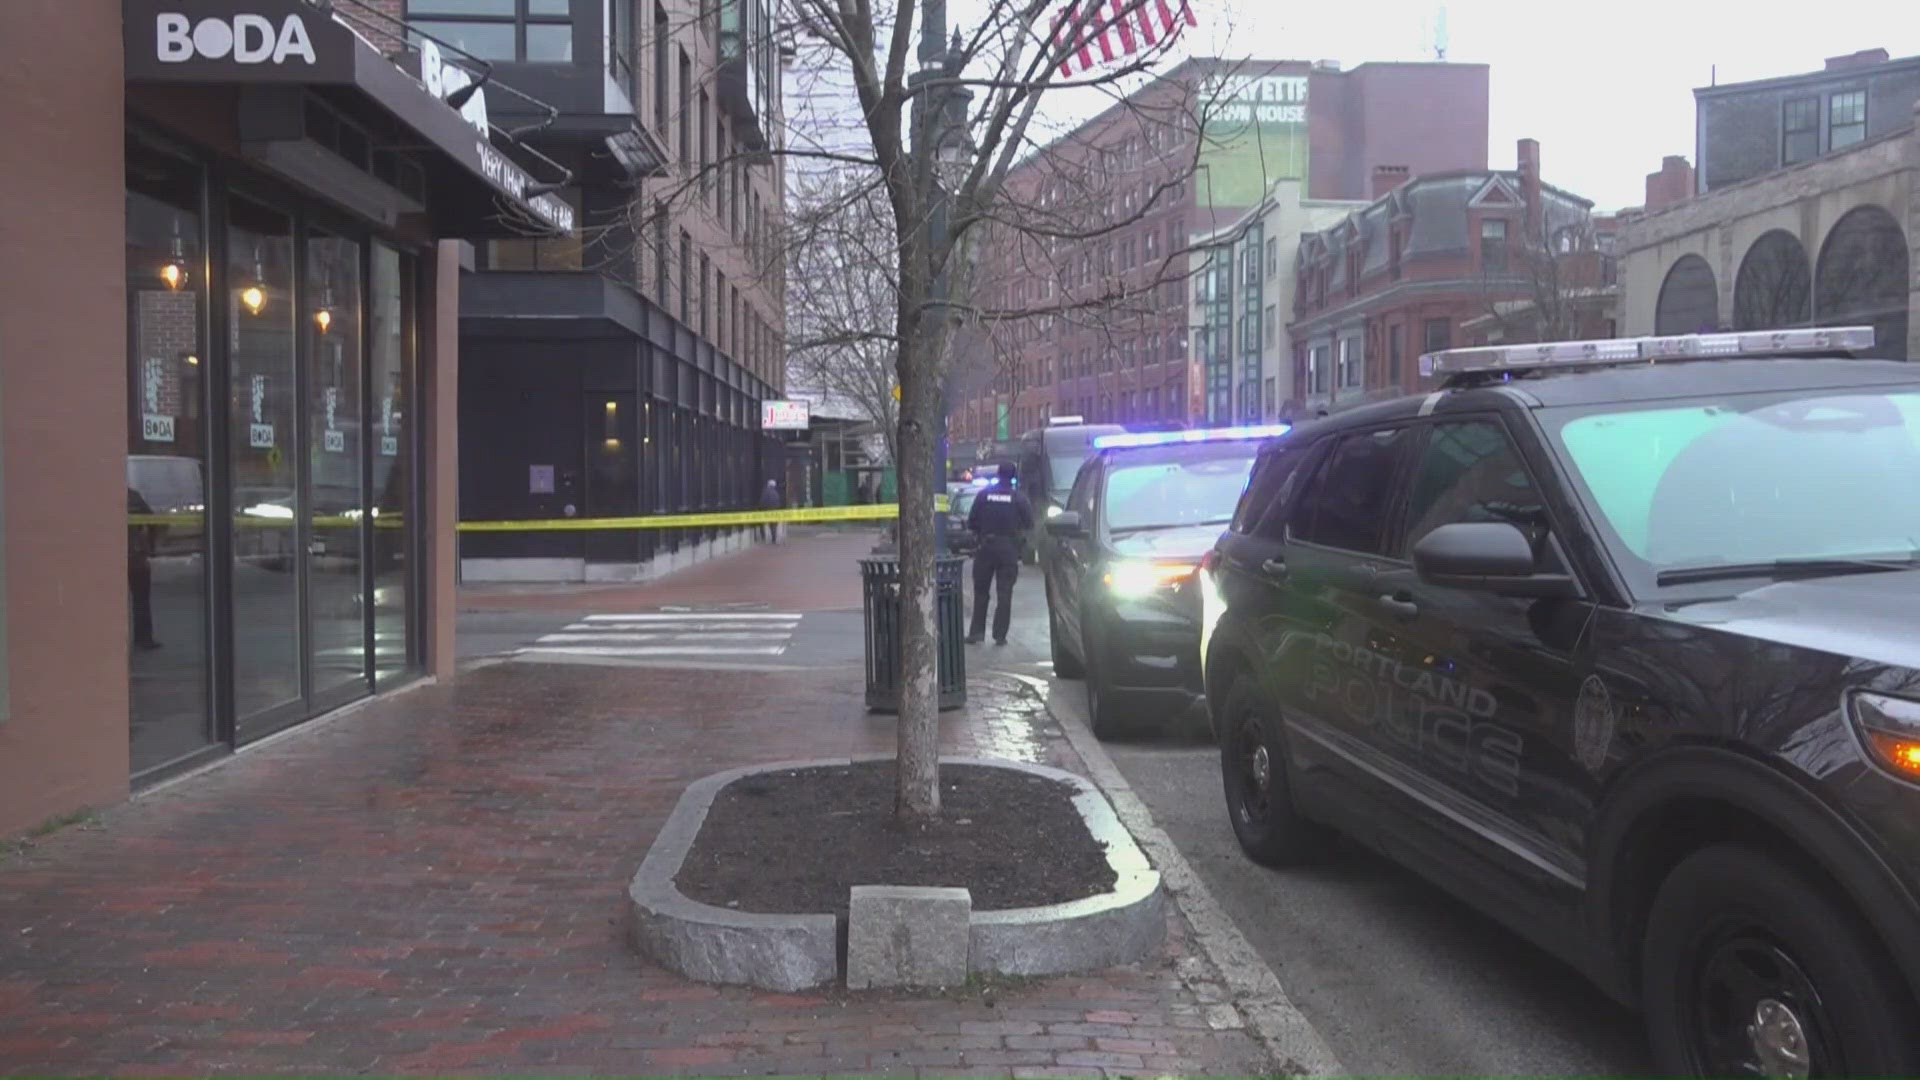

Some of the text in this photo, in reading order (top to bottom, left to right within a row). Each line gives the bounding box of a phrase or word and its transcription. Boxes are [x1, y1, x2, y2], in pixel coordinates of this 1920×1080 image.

[157, 13, 316, 64] BODA
[1201, 105, 1305, 122] TOWN HOUSE
[145, 420, 172, 437] BODA
[1315, 634, 1497, 717] PORTLAND
[1304, 664, 1524, 798] POLICE
